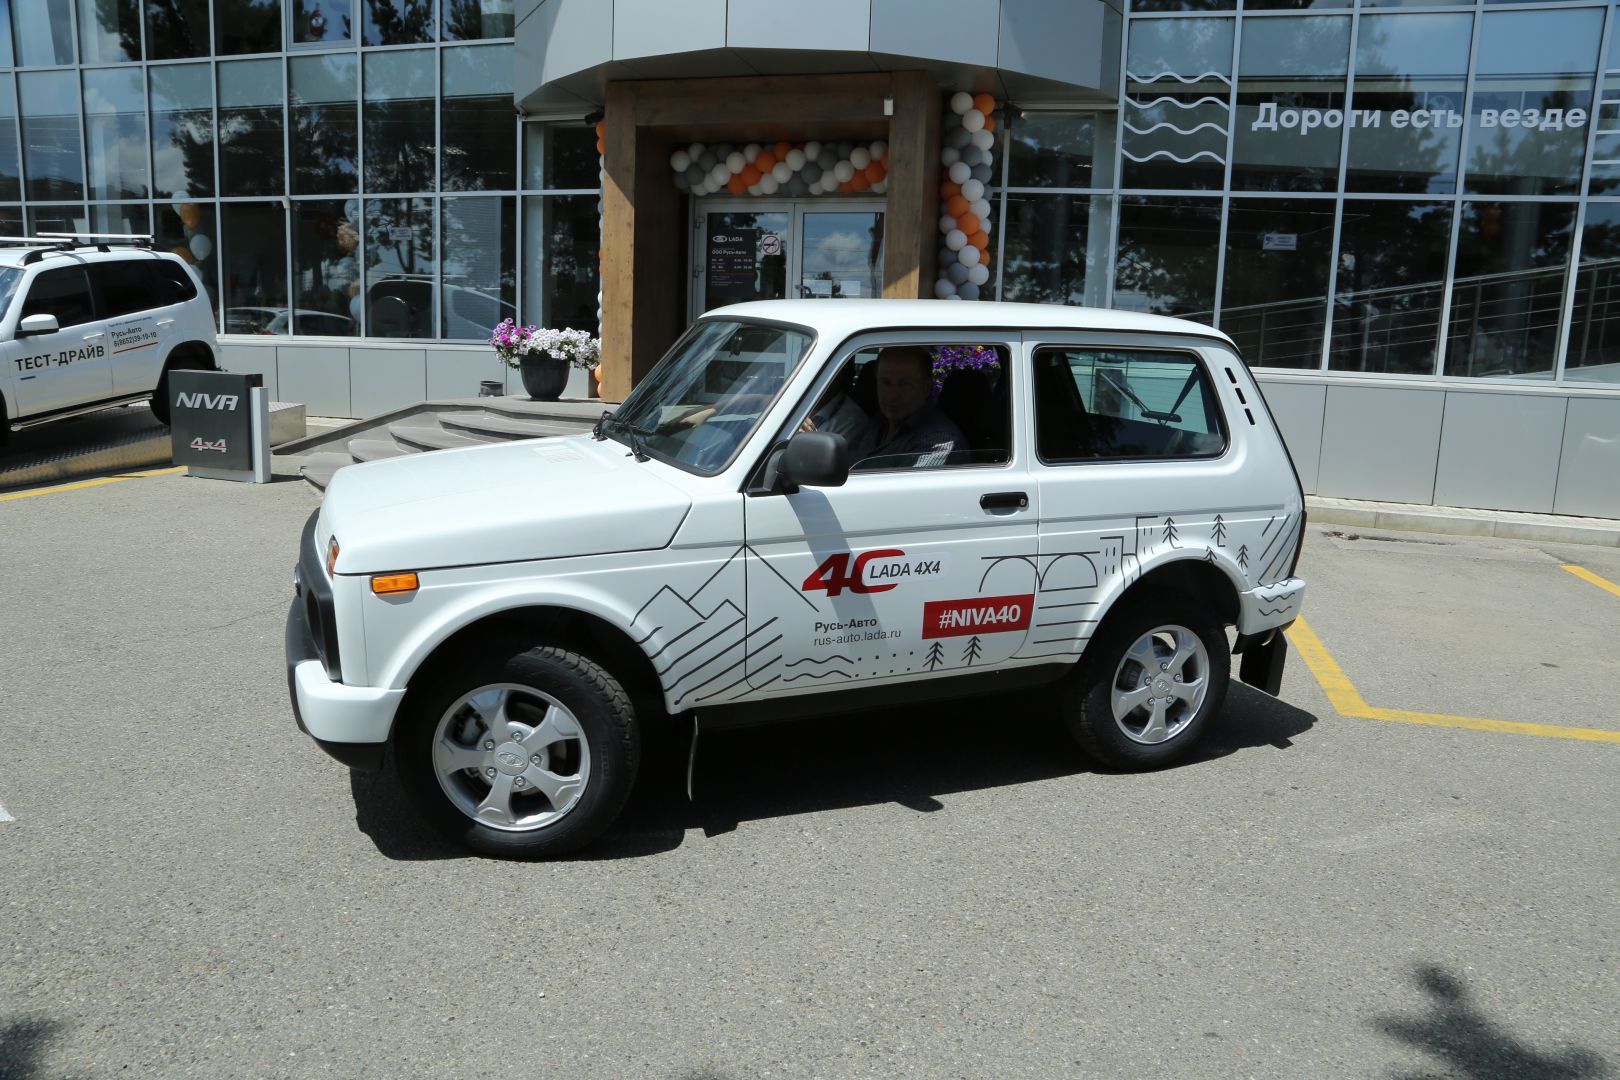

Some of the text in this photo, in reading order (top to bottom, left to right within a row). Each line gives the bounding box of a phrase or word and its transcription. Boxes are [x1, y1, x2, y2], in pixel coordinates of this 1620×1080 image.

[1251, 102, 1588, 135] Дороги есть везде
[111, 327, 142, 339] Русь-Авто
[15, 344, 105, 371] ТЕСТ-ДРАЙВ
[176, 392, 239, 411] NIVA
[869, 562, 910, 579] LADA
[939, 604, 1021, 629] #NIVA40
[814, 618, 877, 634] Русь-Авто
[813, 629, 901, 647] rus-auto.lada.ru
